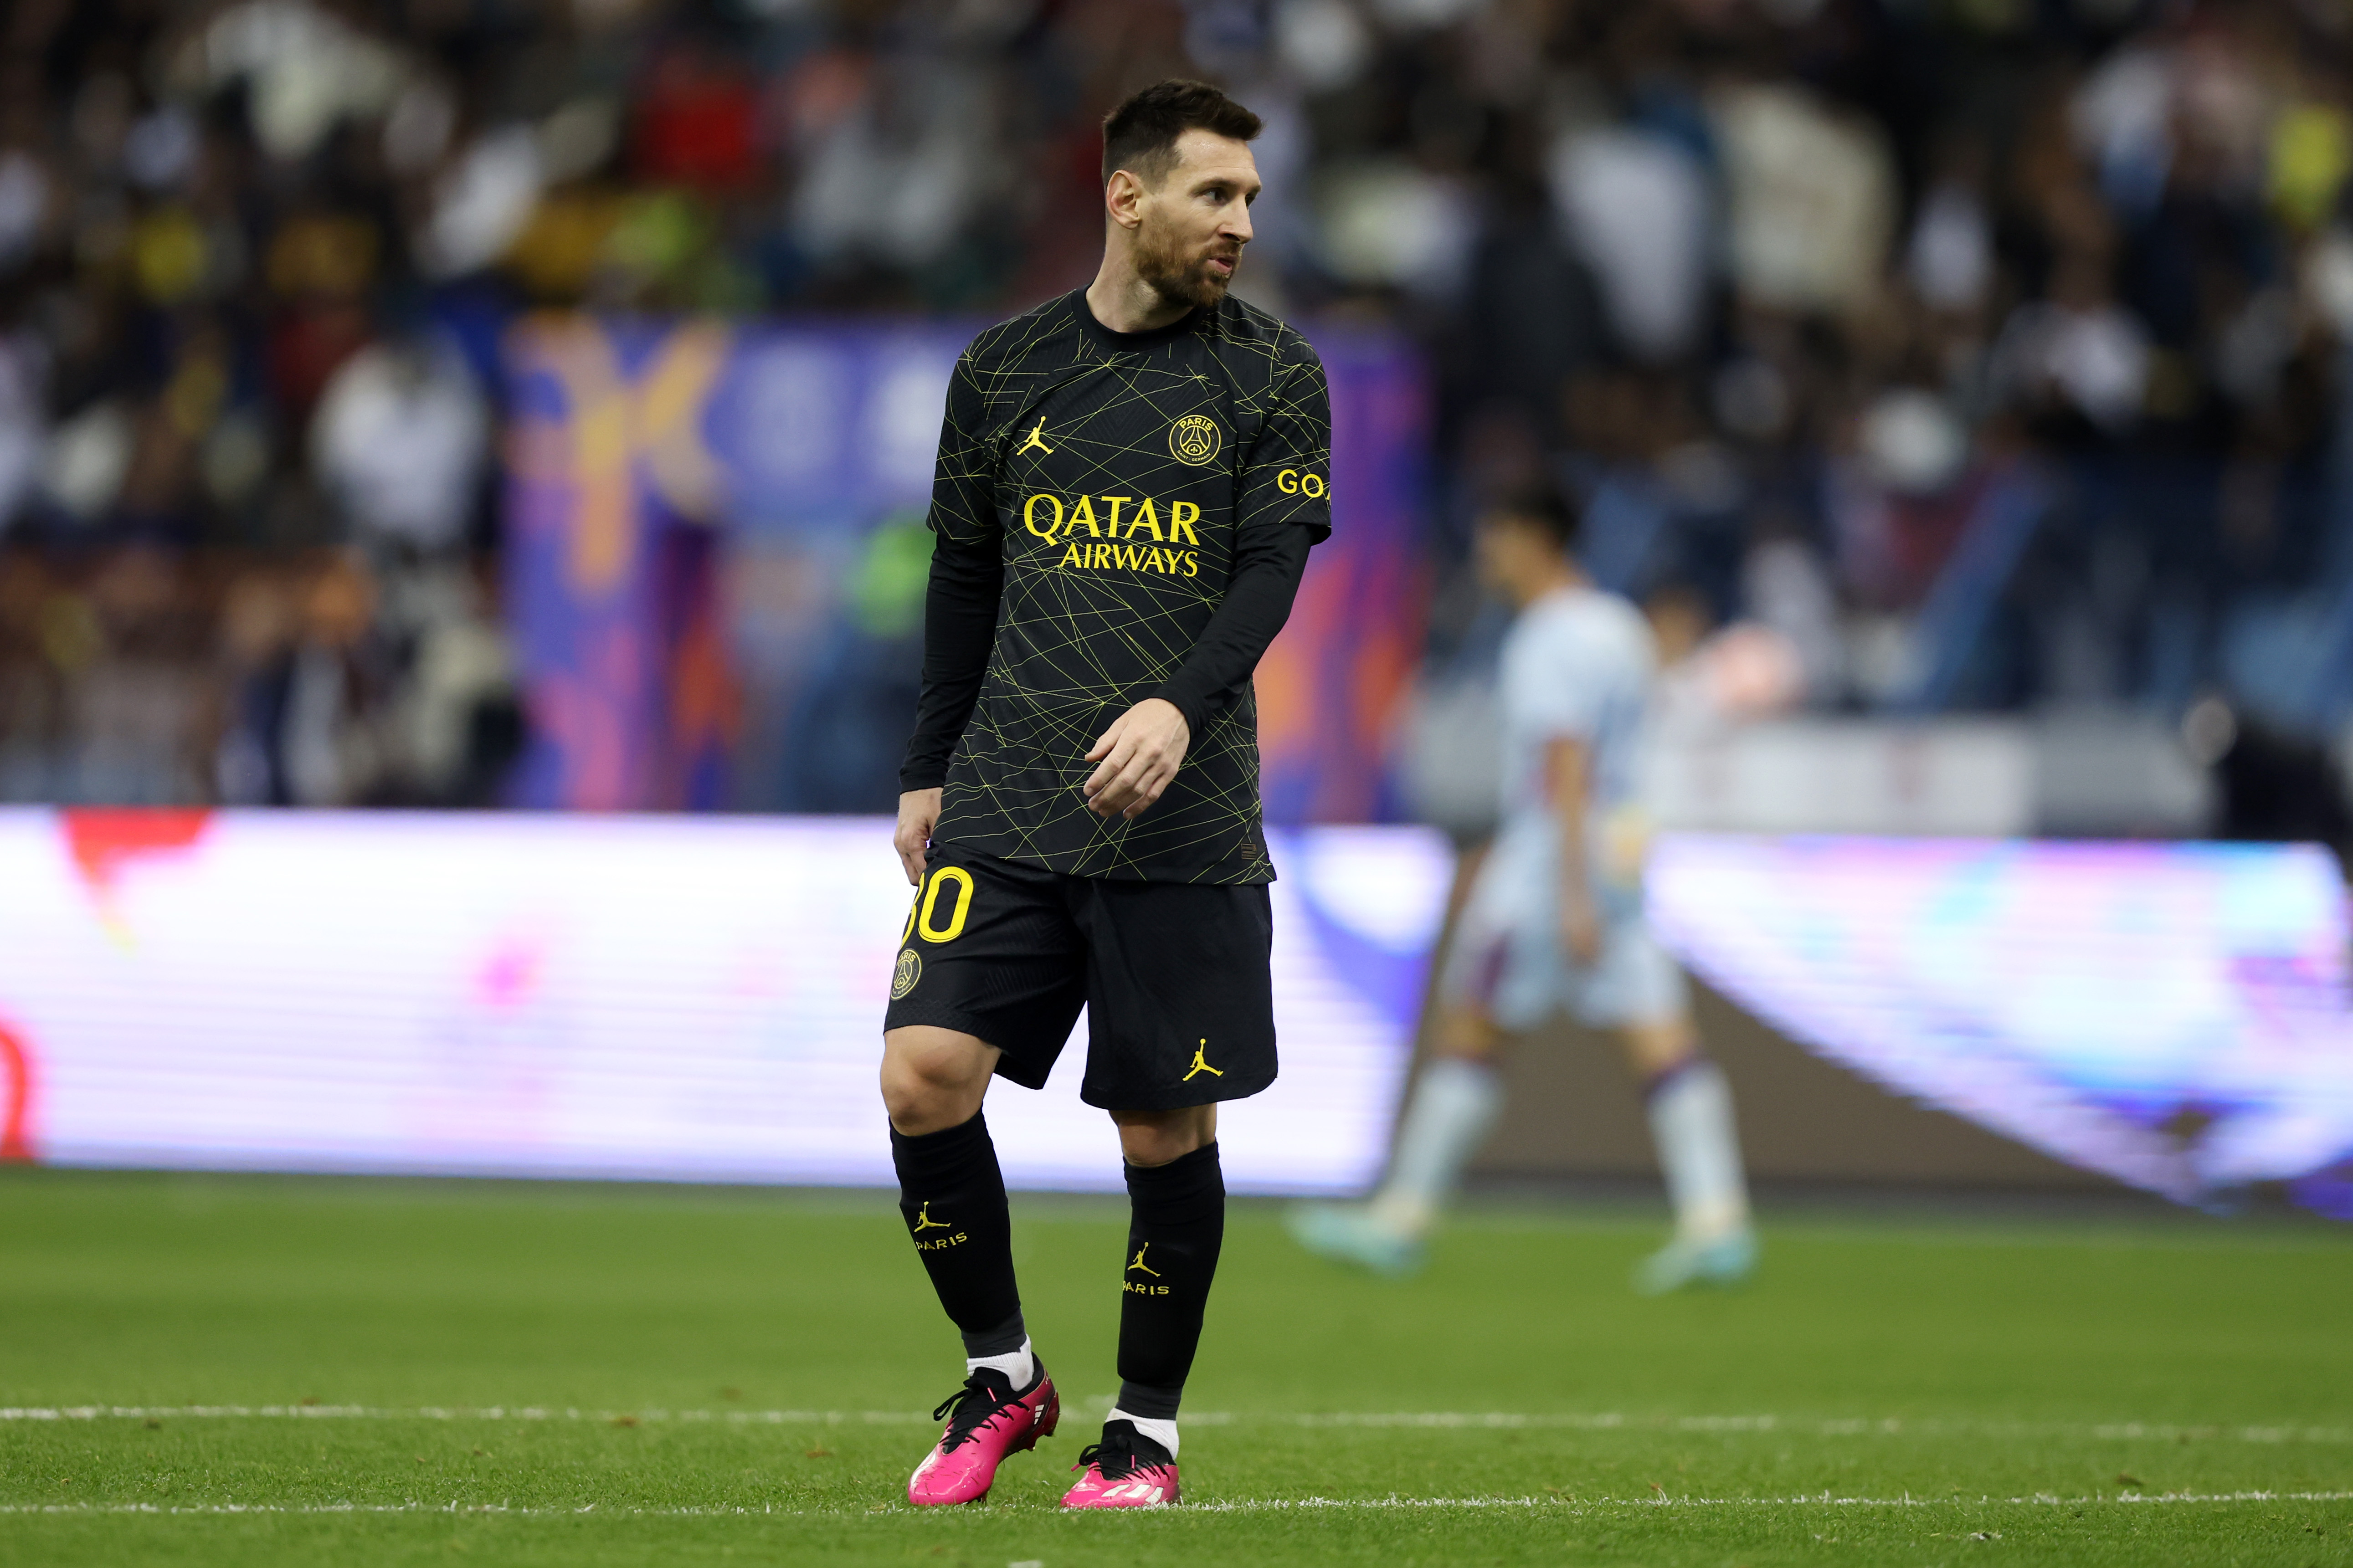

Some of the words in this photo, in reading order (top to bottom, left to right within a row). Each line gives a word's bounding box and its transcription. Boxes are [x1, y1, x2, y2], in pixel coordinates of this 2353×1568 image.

[1179, 418, 1213, 431] PARIS
[1177, 450, 1189, 460] SAINT
[1192, 452, 1211, 462] GERMAIN
[1277, 469, 1331, 500] GO
[1024, 493, 1200, 546] QATAR
[1060, 543, 1198, 578] AIRWAYS
[916, 1232, 967, 1250] PARIS
